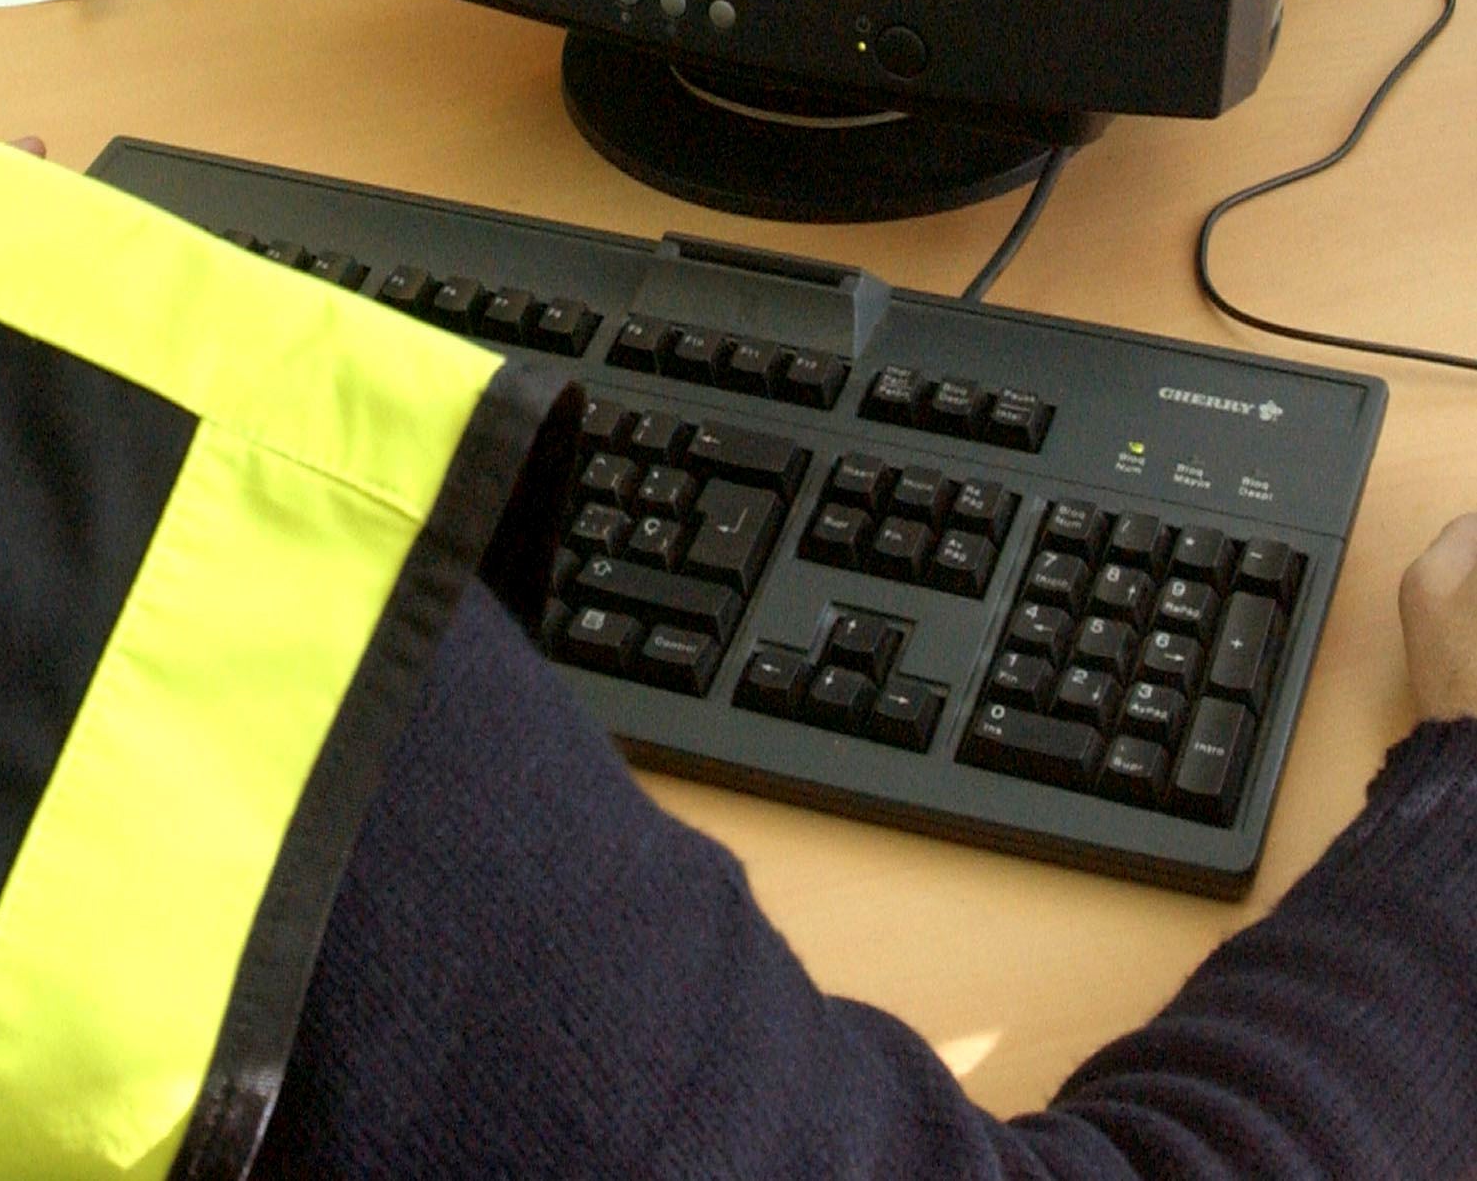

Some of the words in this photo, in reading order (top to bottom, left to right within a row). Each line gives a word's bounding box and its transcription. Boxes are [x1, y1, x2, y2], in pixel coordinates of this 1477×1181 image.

[1158, 386, 1255, 415] CHERRY
[1043, 552, 1059, 567] 7
[1106, 565, 1121, 582] 8
[1171, 581, 1186, 597] 9
[1024, 604, 1040, 619] 4
[1089, 619, 1104, 634] 5
[1154, 631, 1171, 648] 6
[1007, 653, 1018, 667] 1
[1072, 669, 1089, 685] 2
[1137, 683, 1153, 700] 3
[990, 704, 1005, 720] 0
